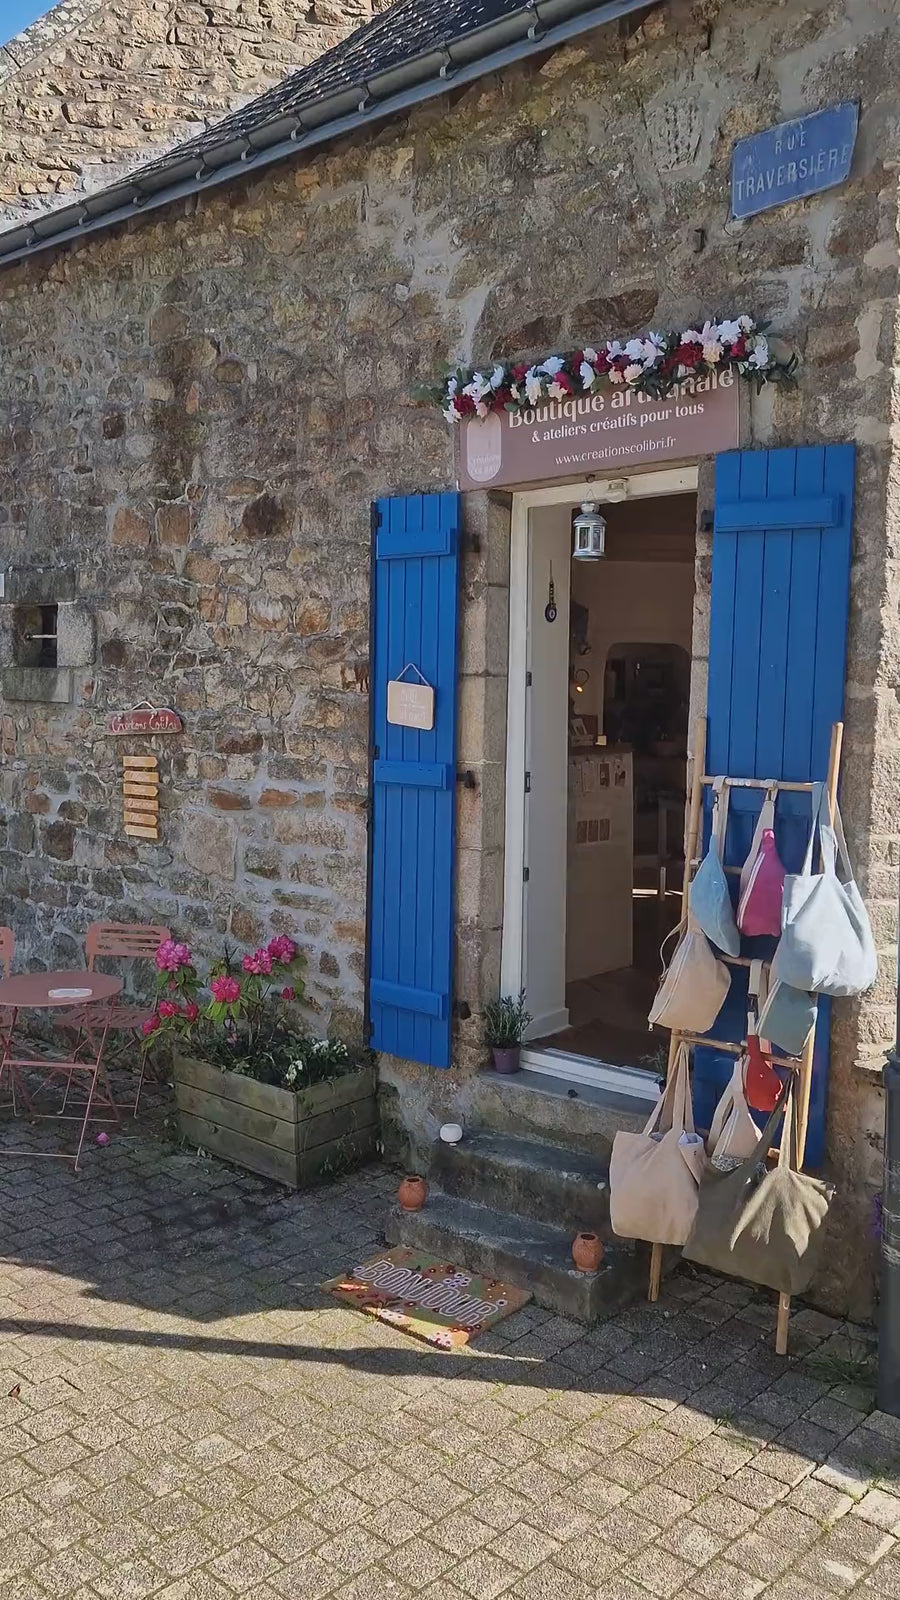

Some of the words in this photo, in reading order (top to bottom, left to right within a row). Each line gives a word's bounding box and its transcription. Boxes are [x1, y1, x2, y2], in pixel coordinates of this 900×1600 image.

[775, 131, 807, 155] RUE
[735, 143, 850, 201] TRAVERSIÈRE
[509, 393, 605, 429] Boutique
[531, 430, 541, 443] &
[543, 423, 587, 441] ateliers
[590, 412, 637, 432] créatifs
[640, 408, 673, 427] pour
[675, 402, 705, 419] tous
[554, 436, 677, 465] www.creationscolibri.fr
[356, 1259, 499, 1327] BONJOUR
